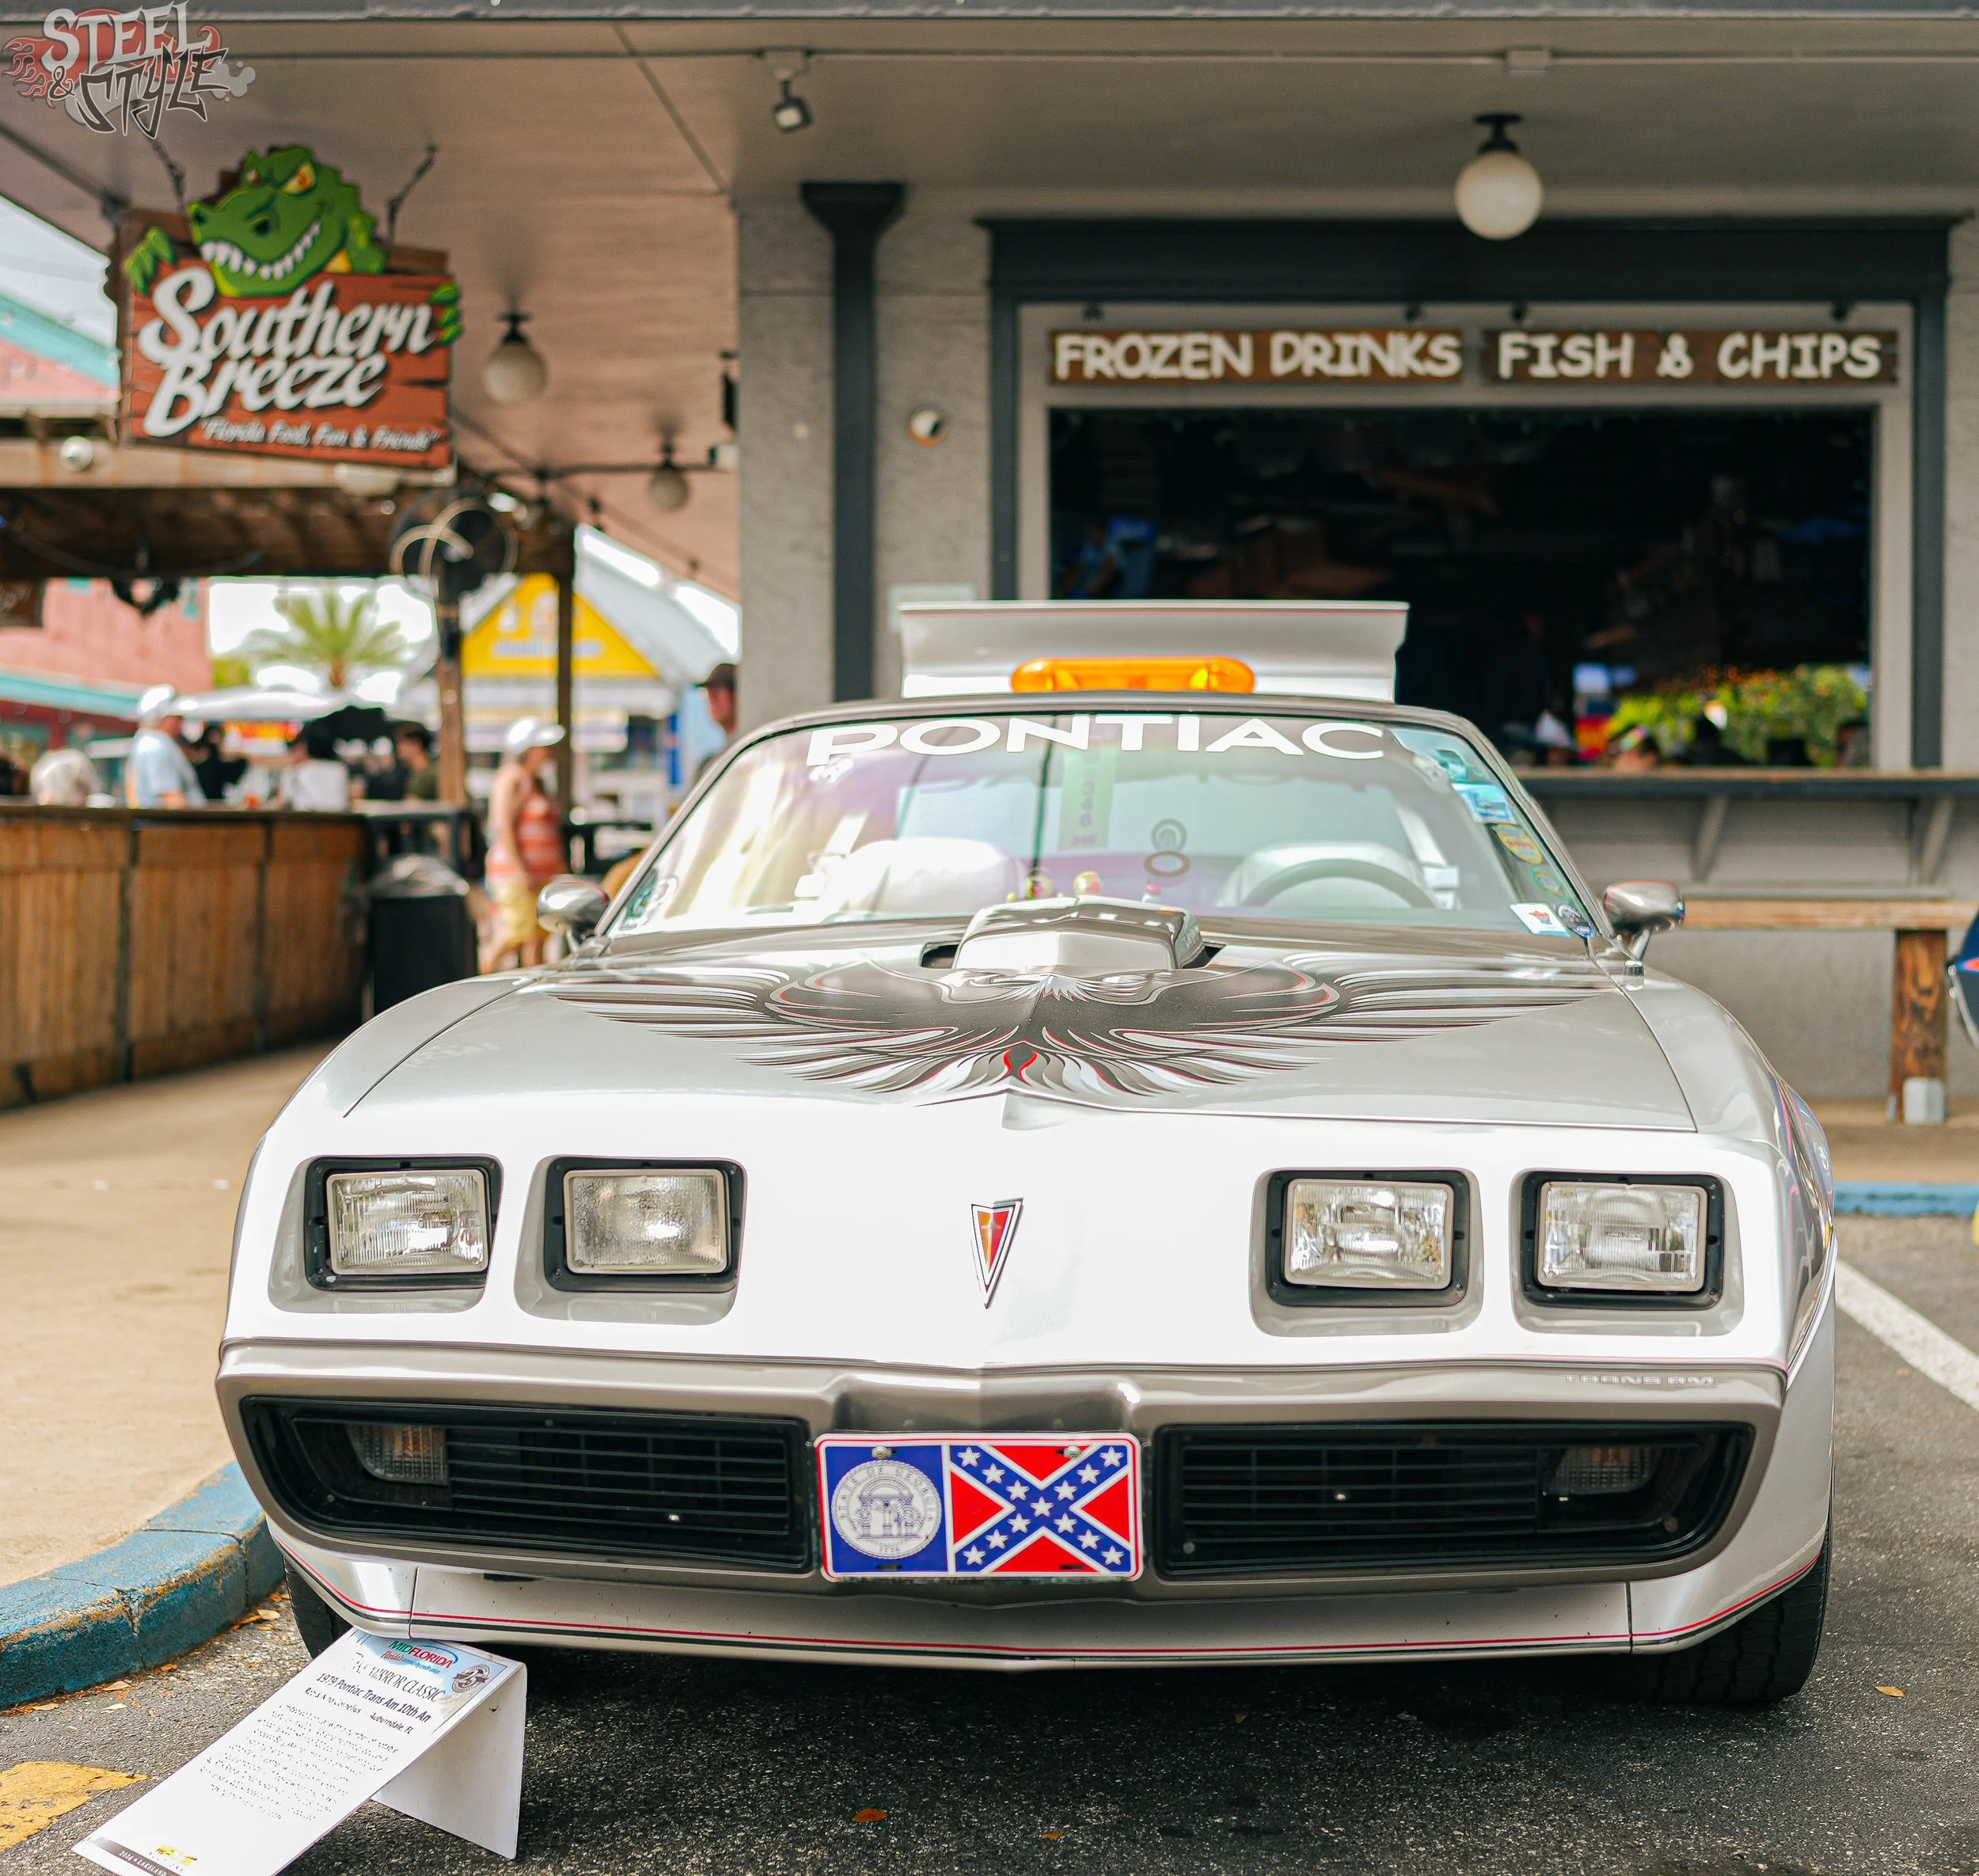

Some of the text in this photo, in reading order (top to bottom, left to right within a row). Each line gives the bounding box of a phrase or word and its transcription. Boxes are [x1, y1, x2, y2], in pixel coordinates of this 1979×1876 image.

[138, 267, 437, 369] Southern
[1054, 331, 1462, 379] FROZEN DRINKS
[1498, 332, 1883, 379] FISH & CHIPS
[142, 351, 387, 437] Breeze
[806, 715, 1384, 766] PONTIAC
[1561, 1374, 1715, 1386] TRANS AM
[388, 1640, 453, 1669] MIDFLORIDA
[335, 1679, 365, 1696] Pontiac
[362, 1689, 386, 1704] Trans
[383, 1698, 401, 1711] Am
[397, 1703, 419, 1718] 10th
[416, 1711, 431, 1722] An
[402, 1677, 446, 1703] CLASSIC
[137, 1859, 168, 1876] LAKELAND
